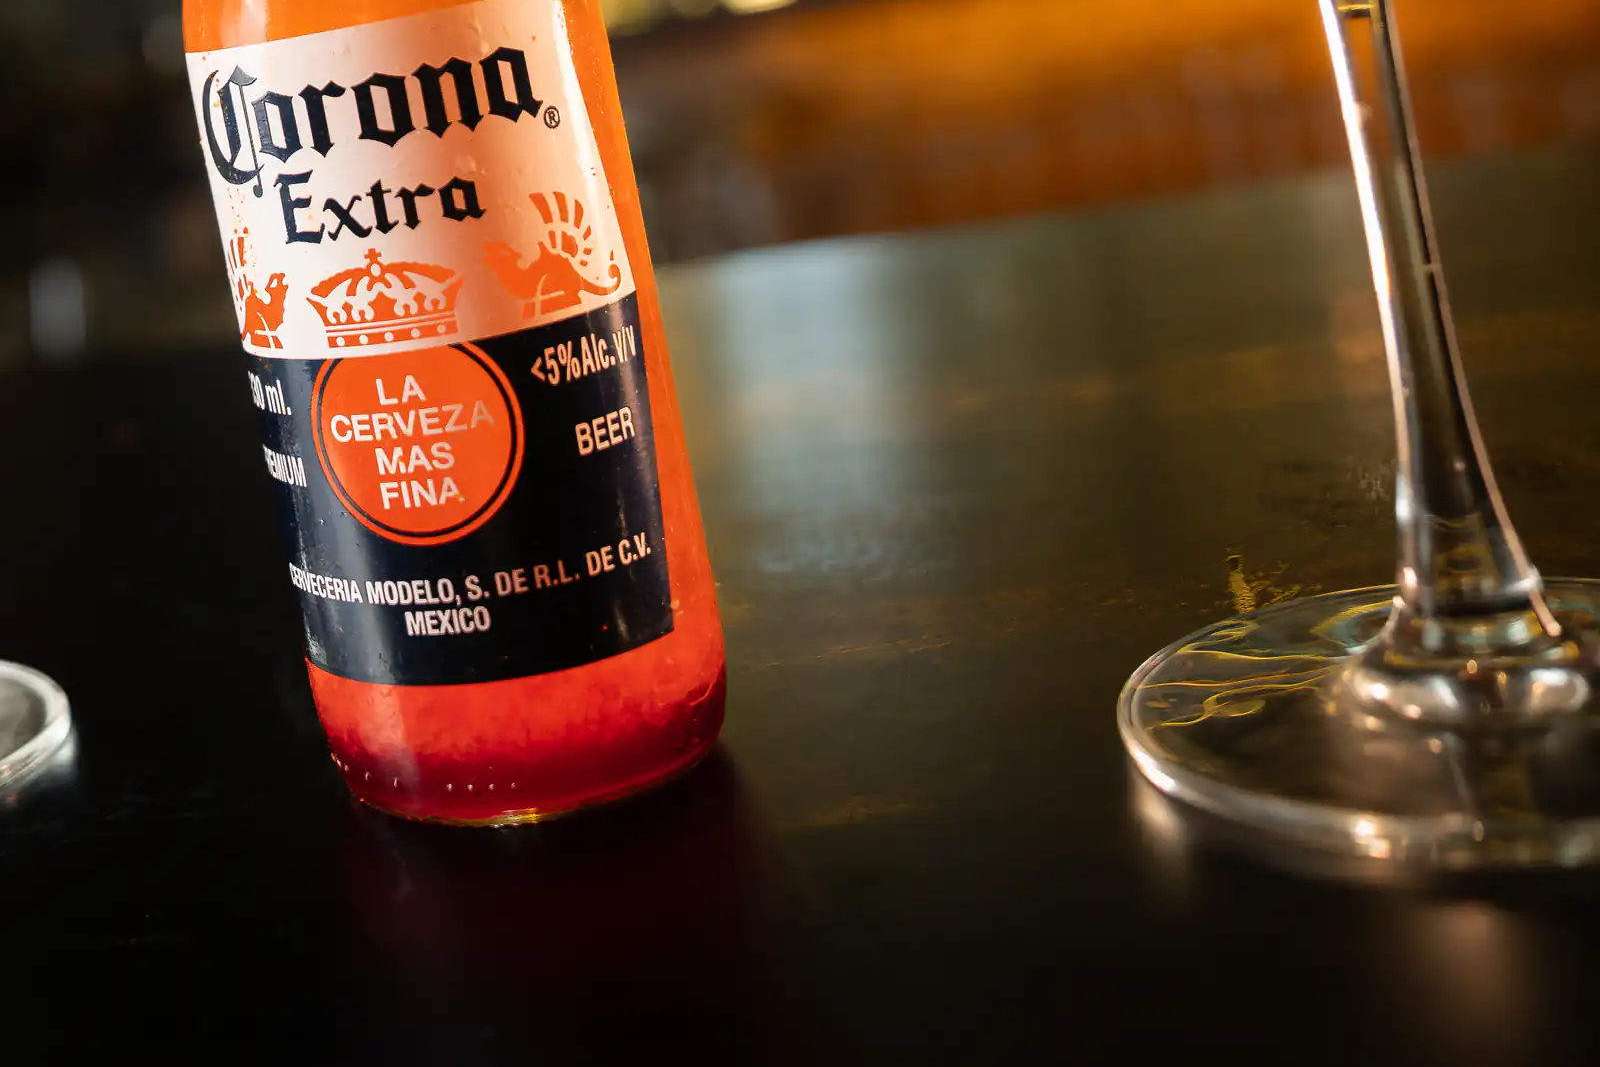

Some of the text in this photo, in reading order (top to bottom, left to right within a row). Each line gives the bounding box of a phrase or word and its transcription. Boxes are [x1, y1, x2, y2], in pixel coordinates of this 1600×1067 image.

[273, 169, 486, 245] Extra
[265, 378, 292, 415] ml.
[375, 374, 427, 406] LA
[330, 400, 495, 443] CERVEZA
[575, 406, 635, 456] BEER
[375, 441, 455, 475] MAS
[379, 477, 465, 510] FINA
[366, 577, 462, 606] MODELO,
[464, 574, 491, 601] S.
[494, 568, 529, 597] DE
[533, 559, 580, 590] R.L.
[585, 545, 615, 577] DE
[618, 531, 652, 566] C.V.
[404, 605, 492, 636] MEXICO
